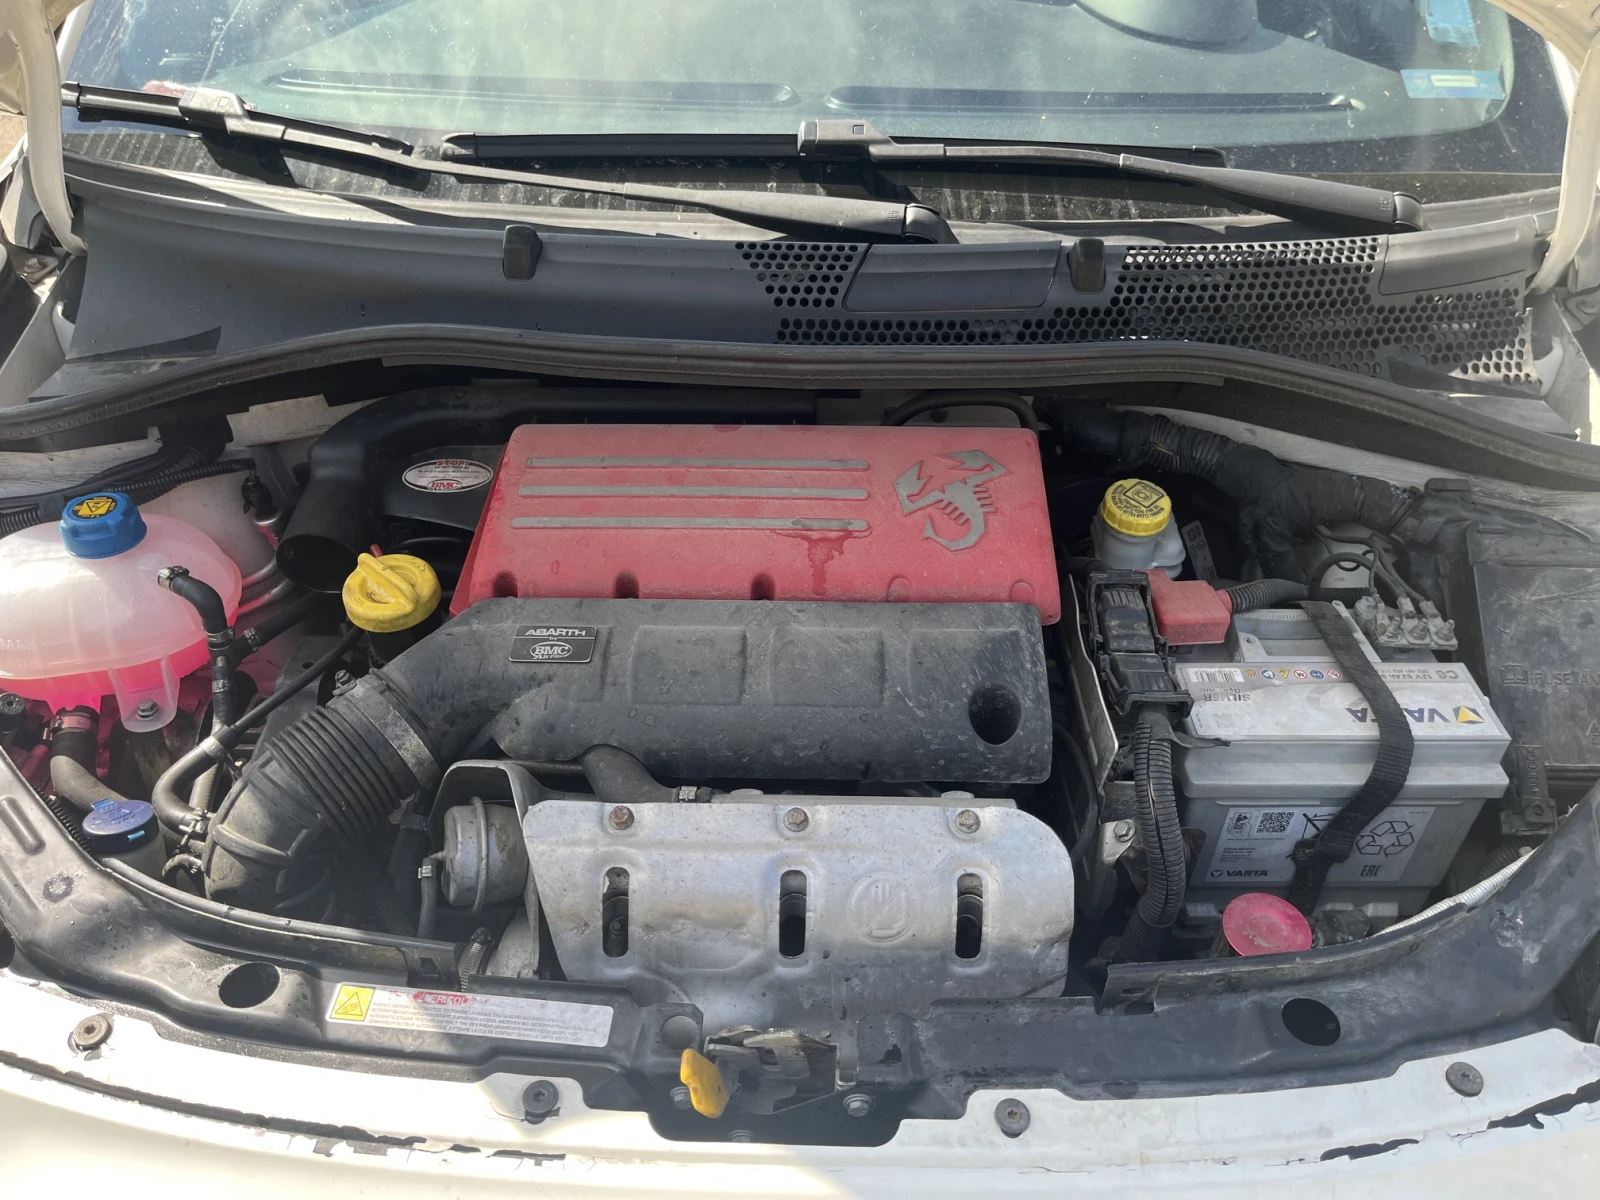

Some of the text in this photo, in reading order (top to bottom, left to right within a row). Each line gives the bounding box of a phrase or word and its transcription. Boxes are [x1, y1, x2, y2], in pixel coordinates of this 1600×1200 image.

[524, 628, 586, 636] ABARTH
[534, 646, 568, 655] BMC
[1436, 670, 1458, 680] C6
[1534, 672, 1572, 686] FUSE
[1204, 694, 1250, 702] SILVER
[1345, 708, 1452, 723] VAA
